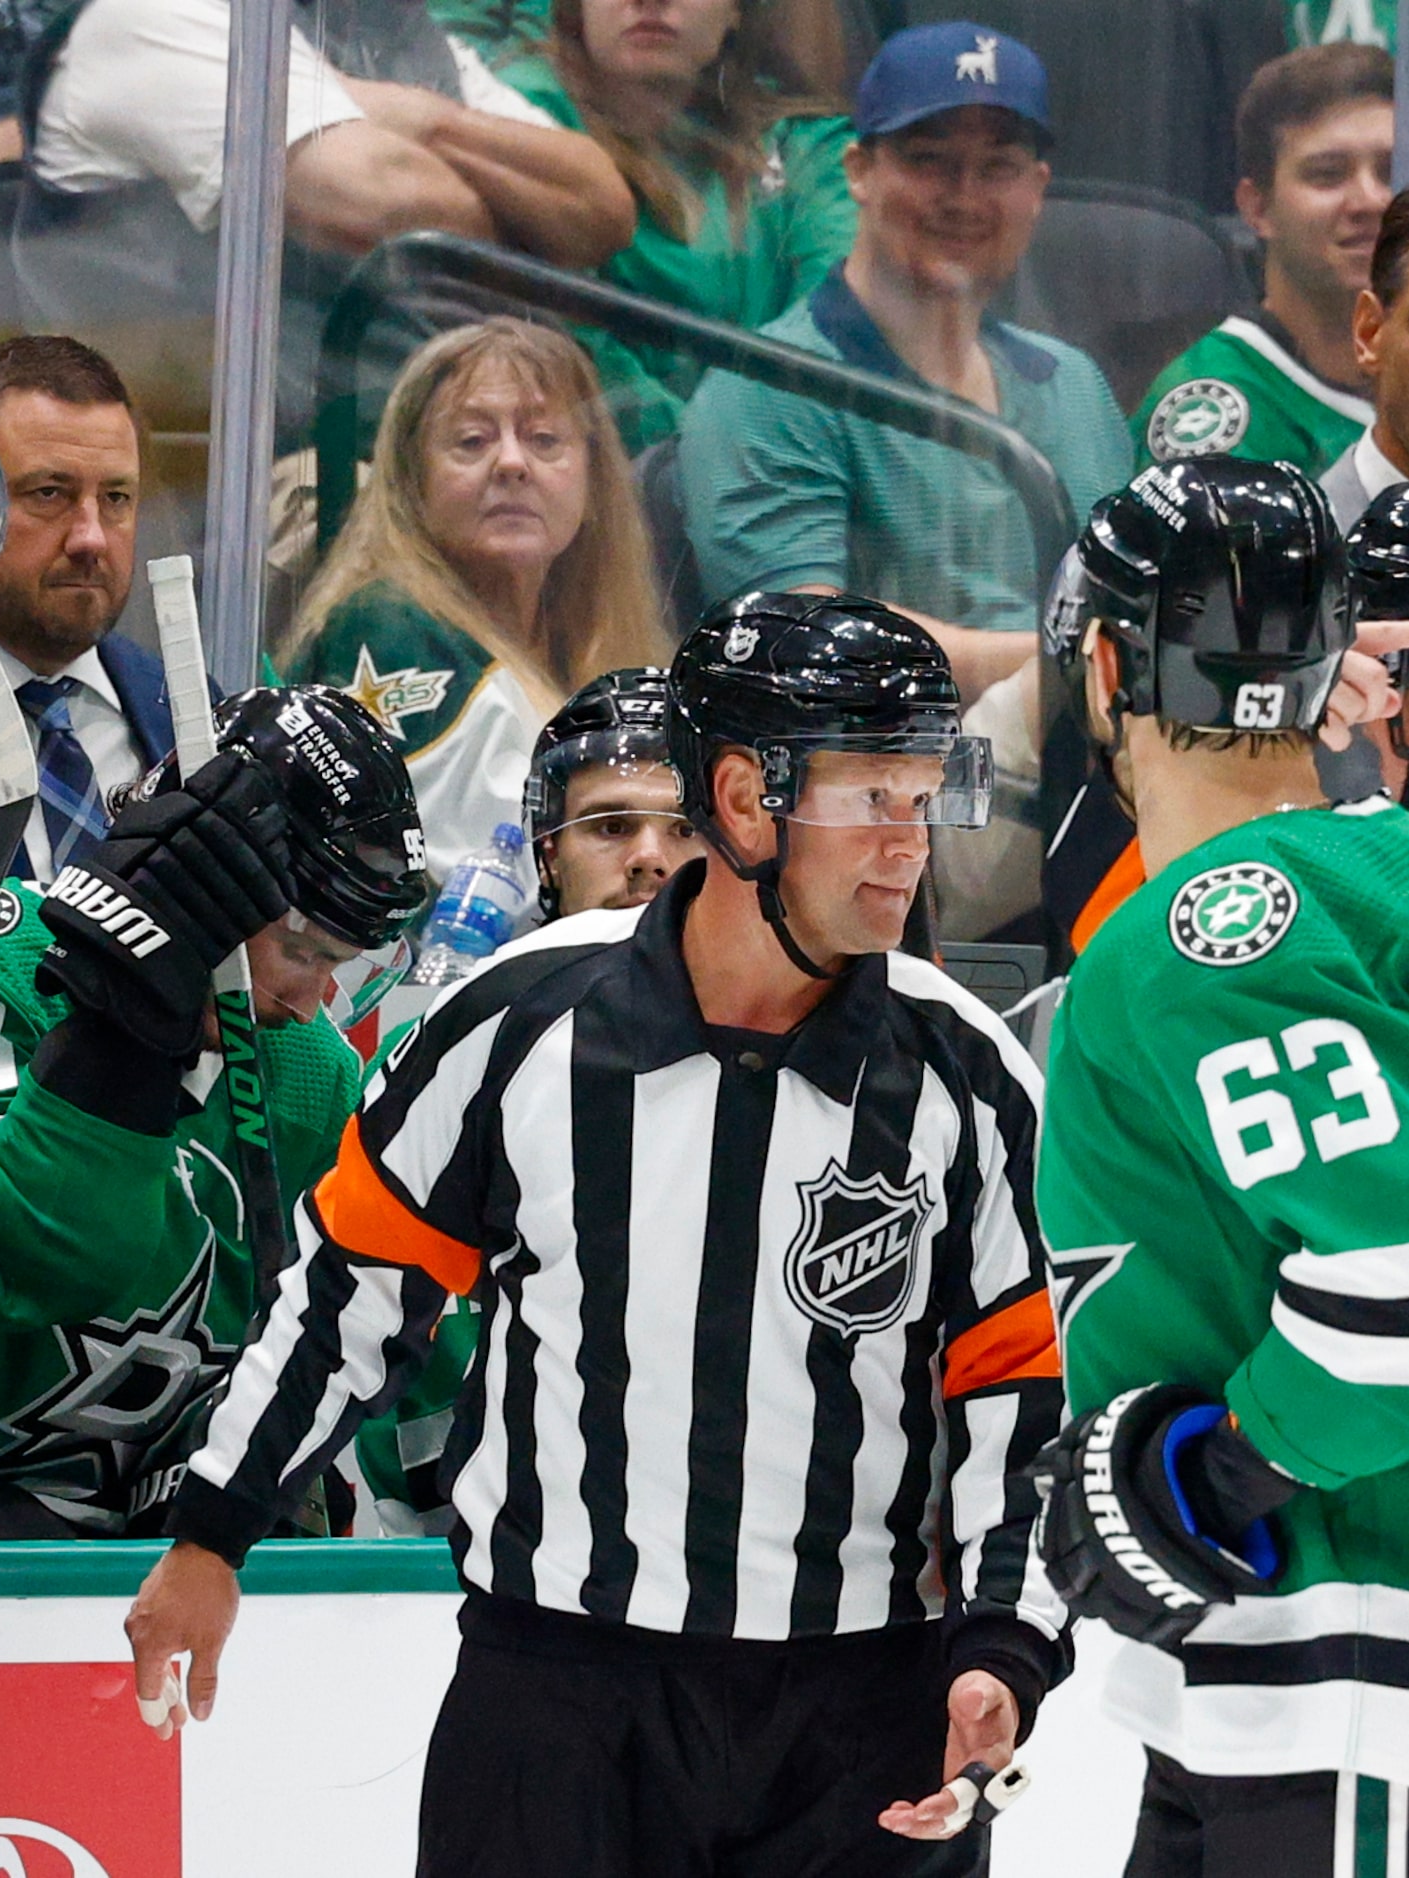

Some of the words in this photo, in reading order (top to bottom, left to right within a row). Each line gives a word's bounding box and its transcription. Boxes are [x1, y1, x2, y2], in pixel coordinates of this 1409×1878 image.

[1233, 683, 1285, 729] 63
[296, 734, 352, 807] TRANSFER
[307, 723, 361, 782] ENERGY
[1177, 871, 1284, 921] DALLAS
[1190, 911, 1286, 958] STARS
[1195, 1017, 1401, 1192] 63
[818, 1220, 909, 1294] NHL
